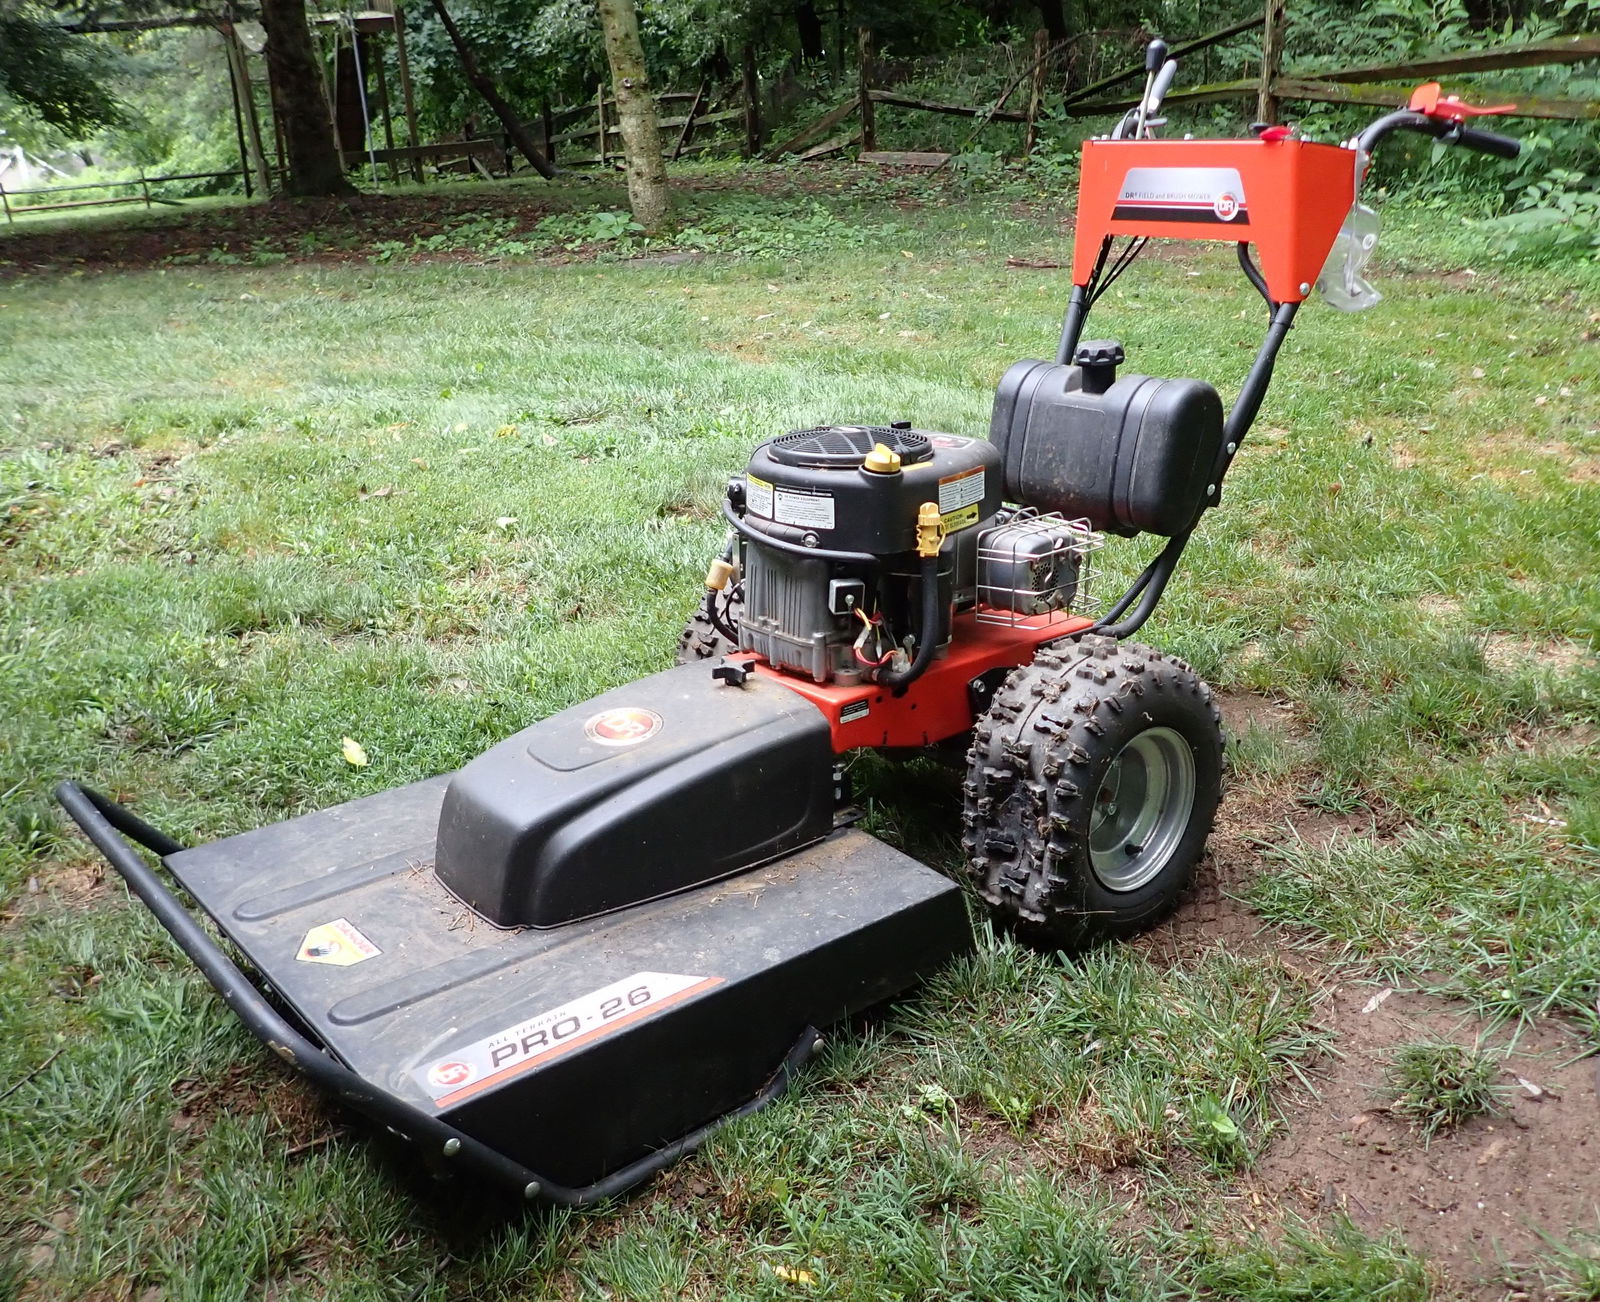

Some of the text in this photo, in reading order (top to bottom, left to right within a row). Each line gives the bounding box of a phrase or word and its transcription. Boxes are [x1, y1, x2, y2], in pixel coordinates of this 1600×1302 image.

[1139, 192, 1155, 200] FIELD
[488, 1010, 568, 1049] ALL TERRAIN
